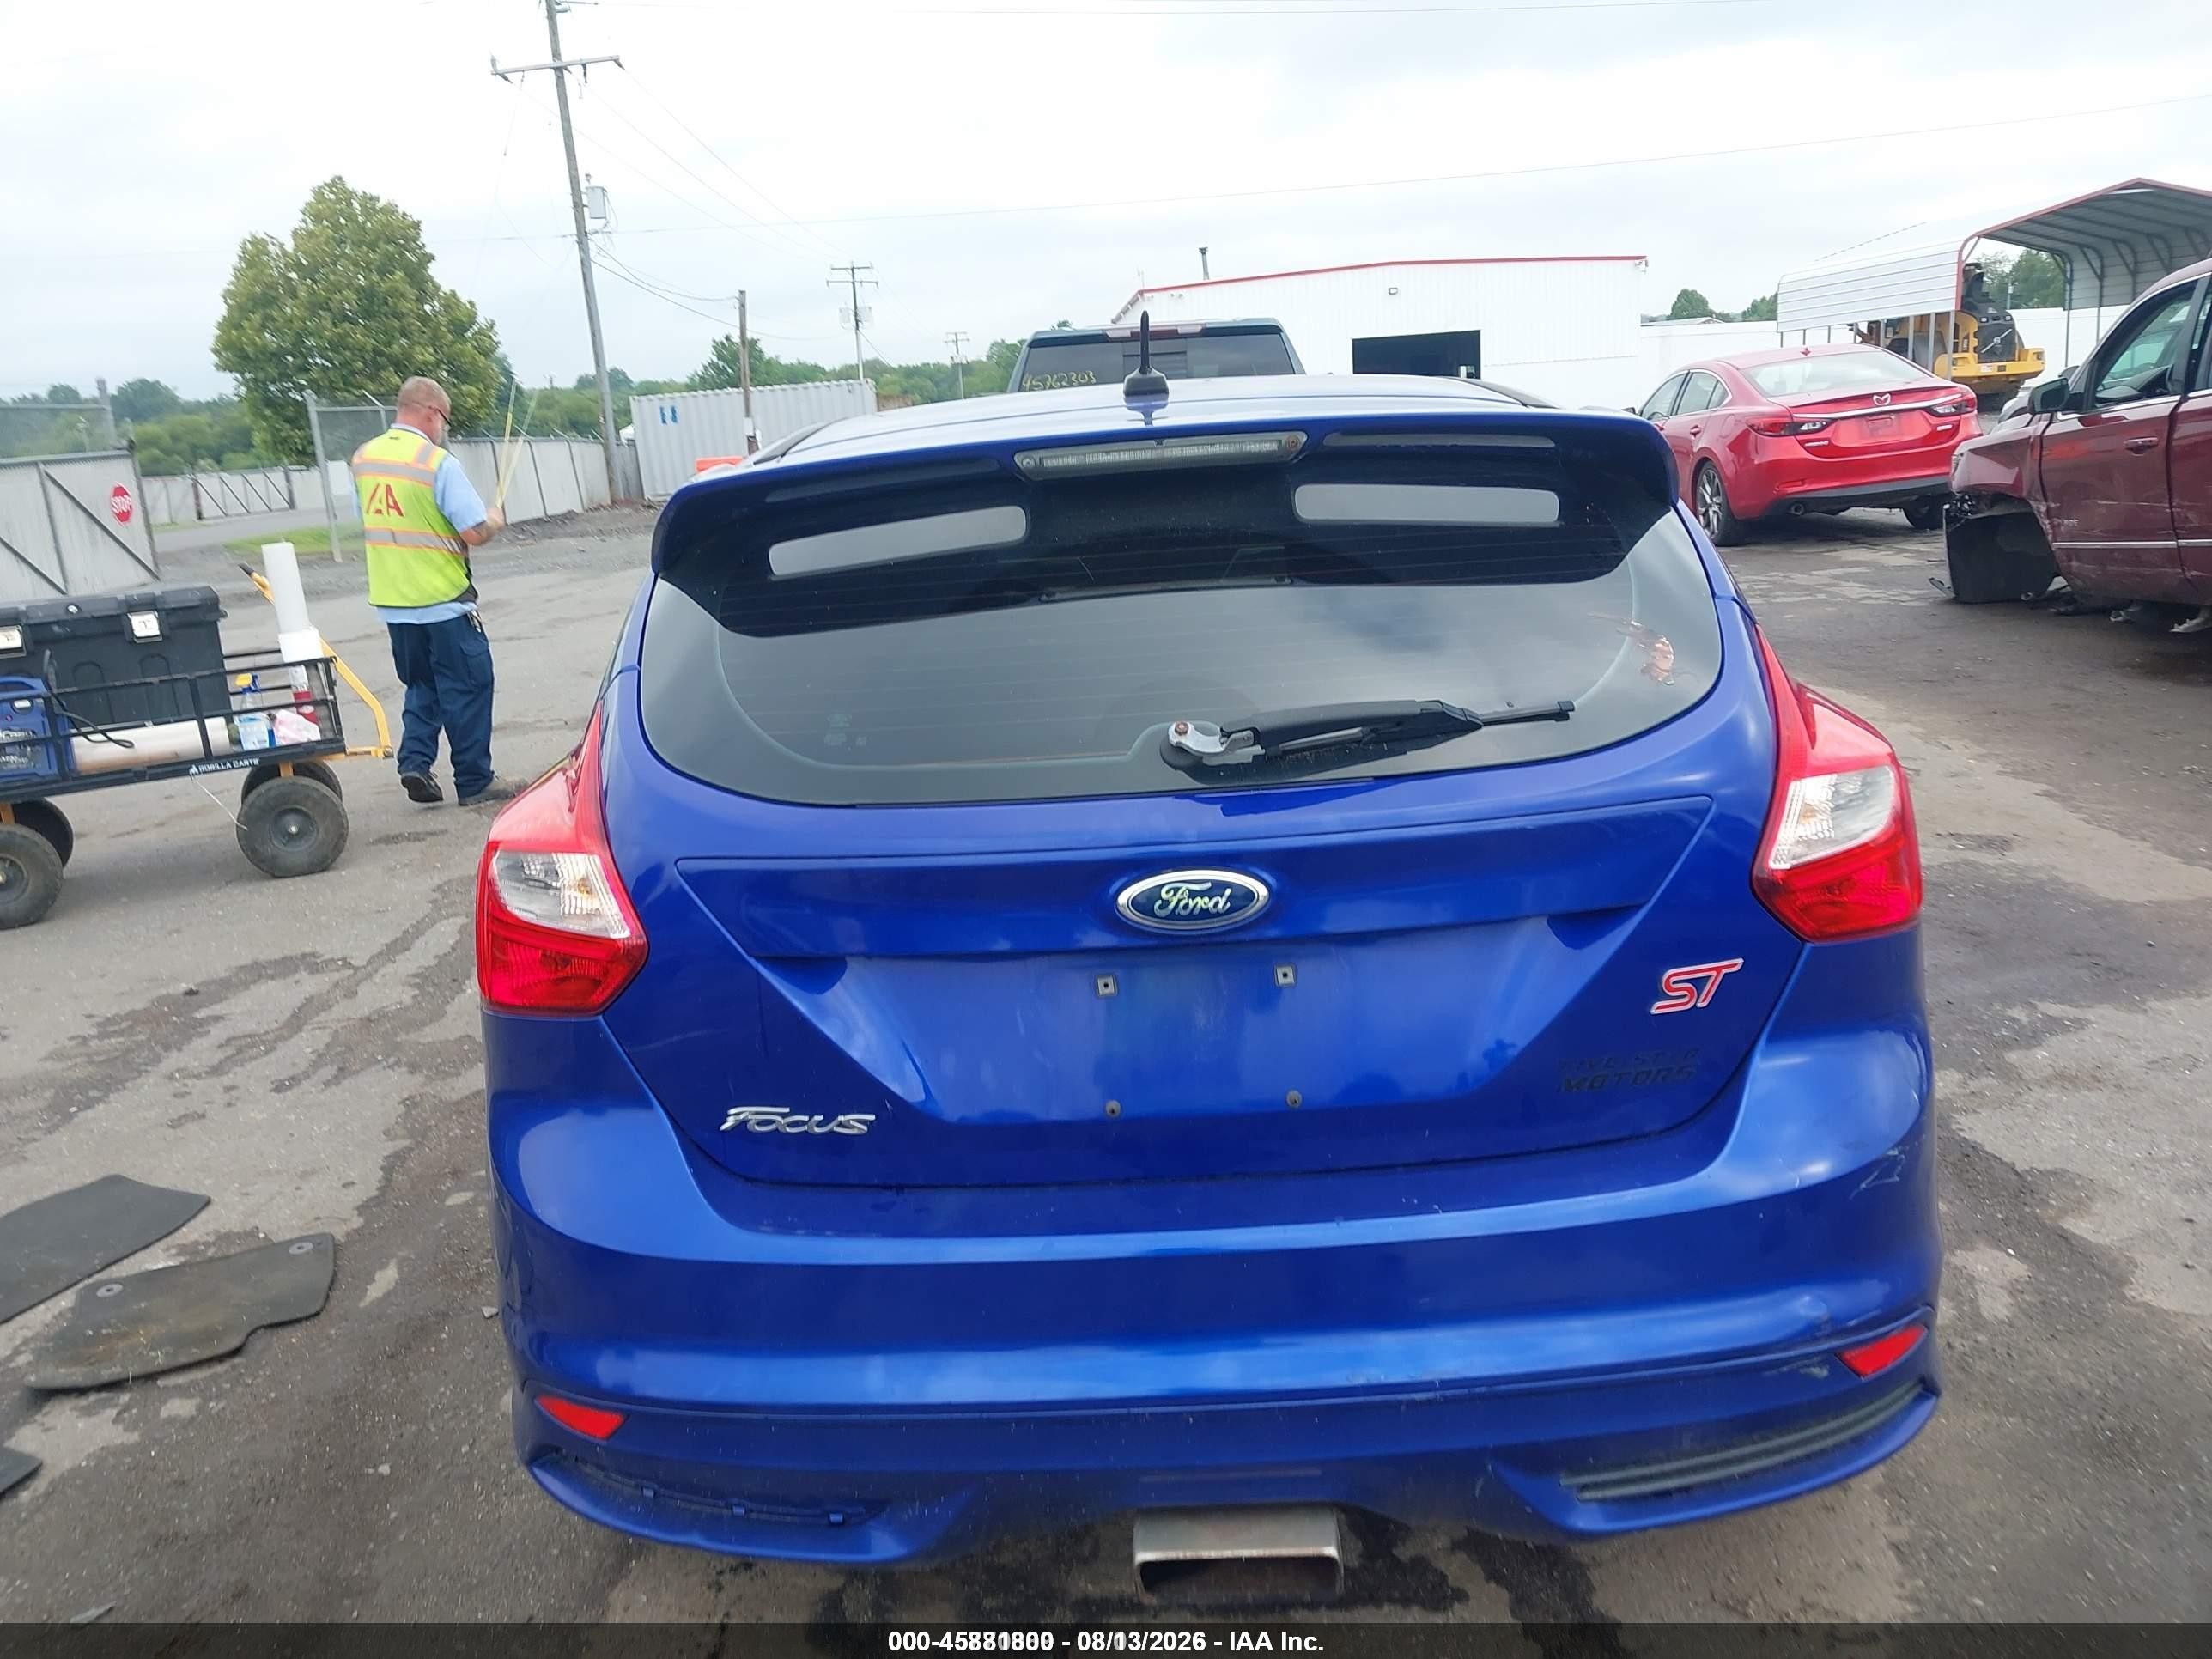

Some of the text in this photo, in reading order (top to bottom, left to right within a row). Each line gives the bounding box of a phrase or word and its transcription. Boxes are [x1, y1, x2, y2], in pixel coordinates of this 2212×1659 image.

[111, 495, 131, 514] STOP
[1153, 881, 1231, 918] Ford
[1650, 957, 1745, 1016] ST
